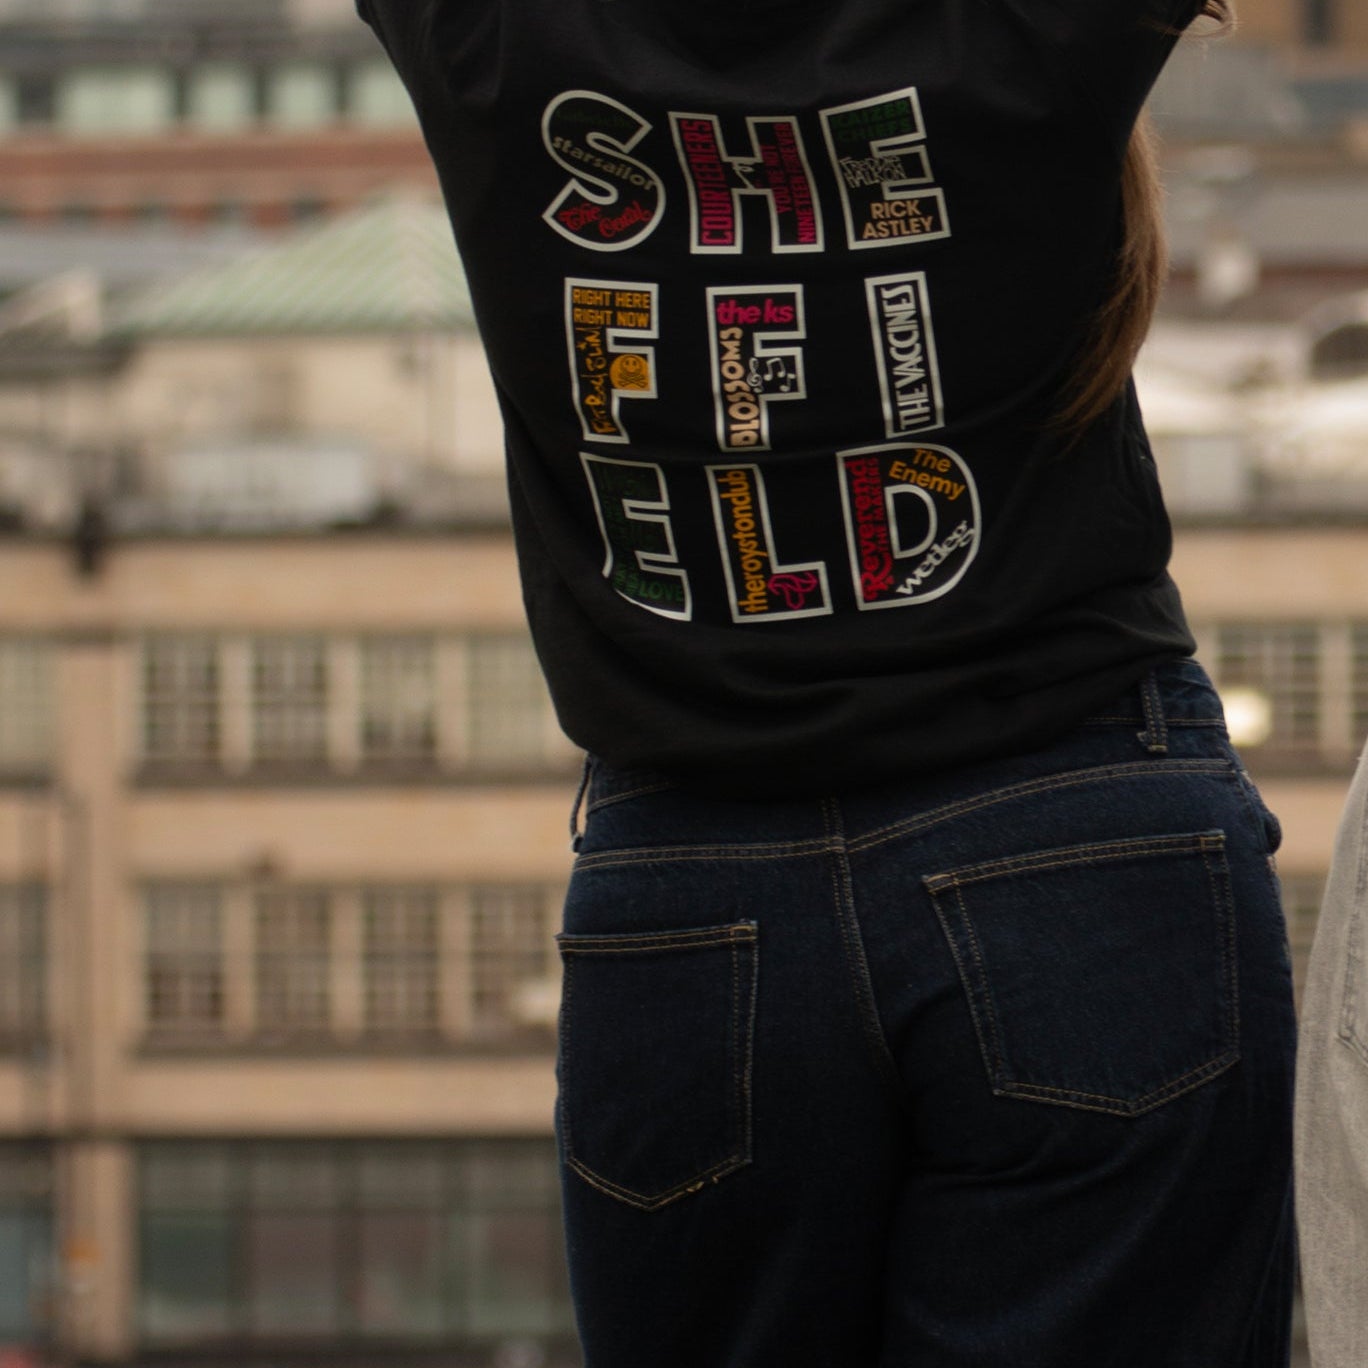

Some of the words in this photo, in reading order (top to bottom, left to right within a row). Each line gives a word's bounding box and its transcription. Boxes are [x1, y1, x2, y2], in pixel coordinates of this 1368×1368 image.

[552, 136, 657, 191] starsailor
[679, 119, 734, 245] COURTEENERS
[870, 199, 922, 220] RICK
[862, 215, 934, 239] ASTLEY
[572, 288, 613, 306] RIGHT
[614, 290, 651, 310] HERE
[717, 304, 762, 326] the
[572, 307, 614, 326] RIGHT
[615, 311, 649, 329] NOW
[880, 283, 926, 390] VACCINES
[719, 326, 760, 448] BLOSSOMS
[896, 382, 931, 431] THE
[913, 448, 951, 474] The
[888, 460, 966, 502] Enemy
[844, 457, 893, 602] Reverend
[639, 581, 683, 605] LOVE
